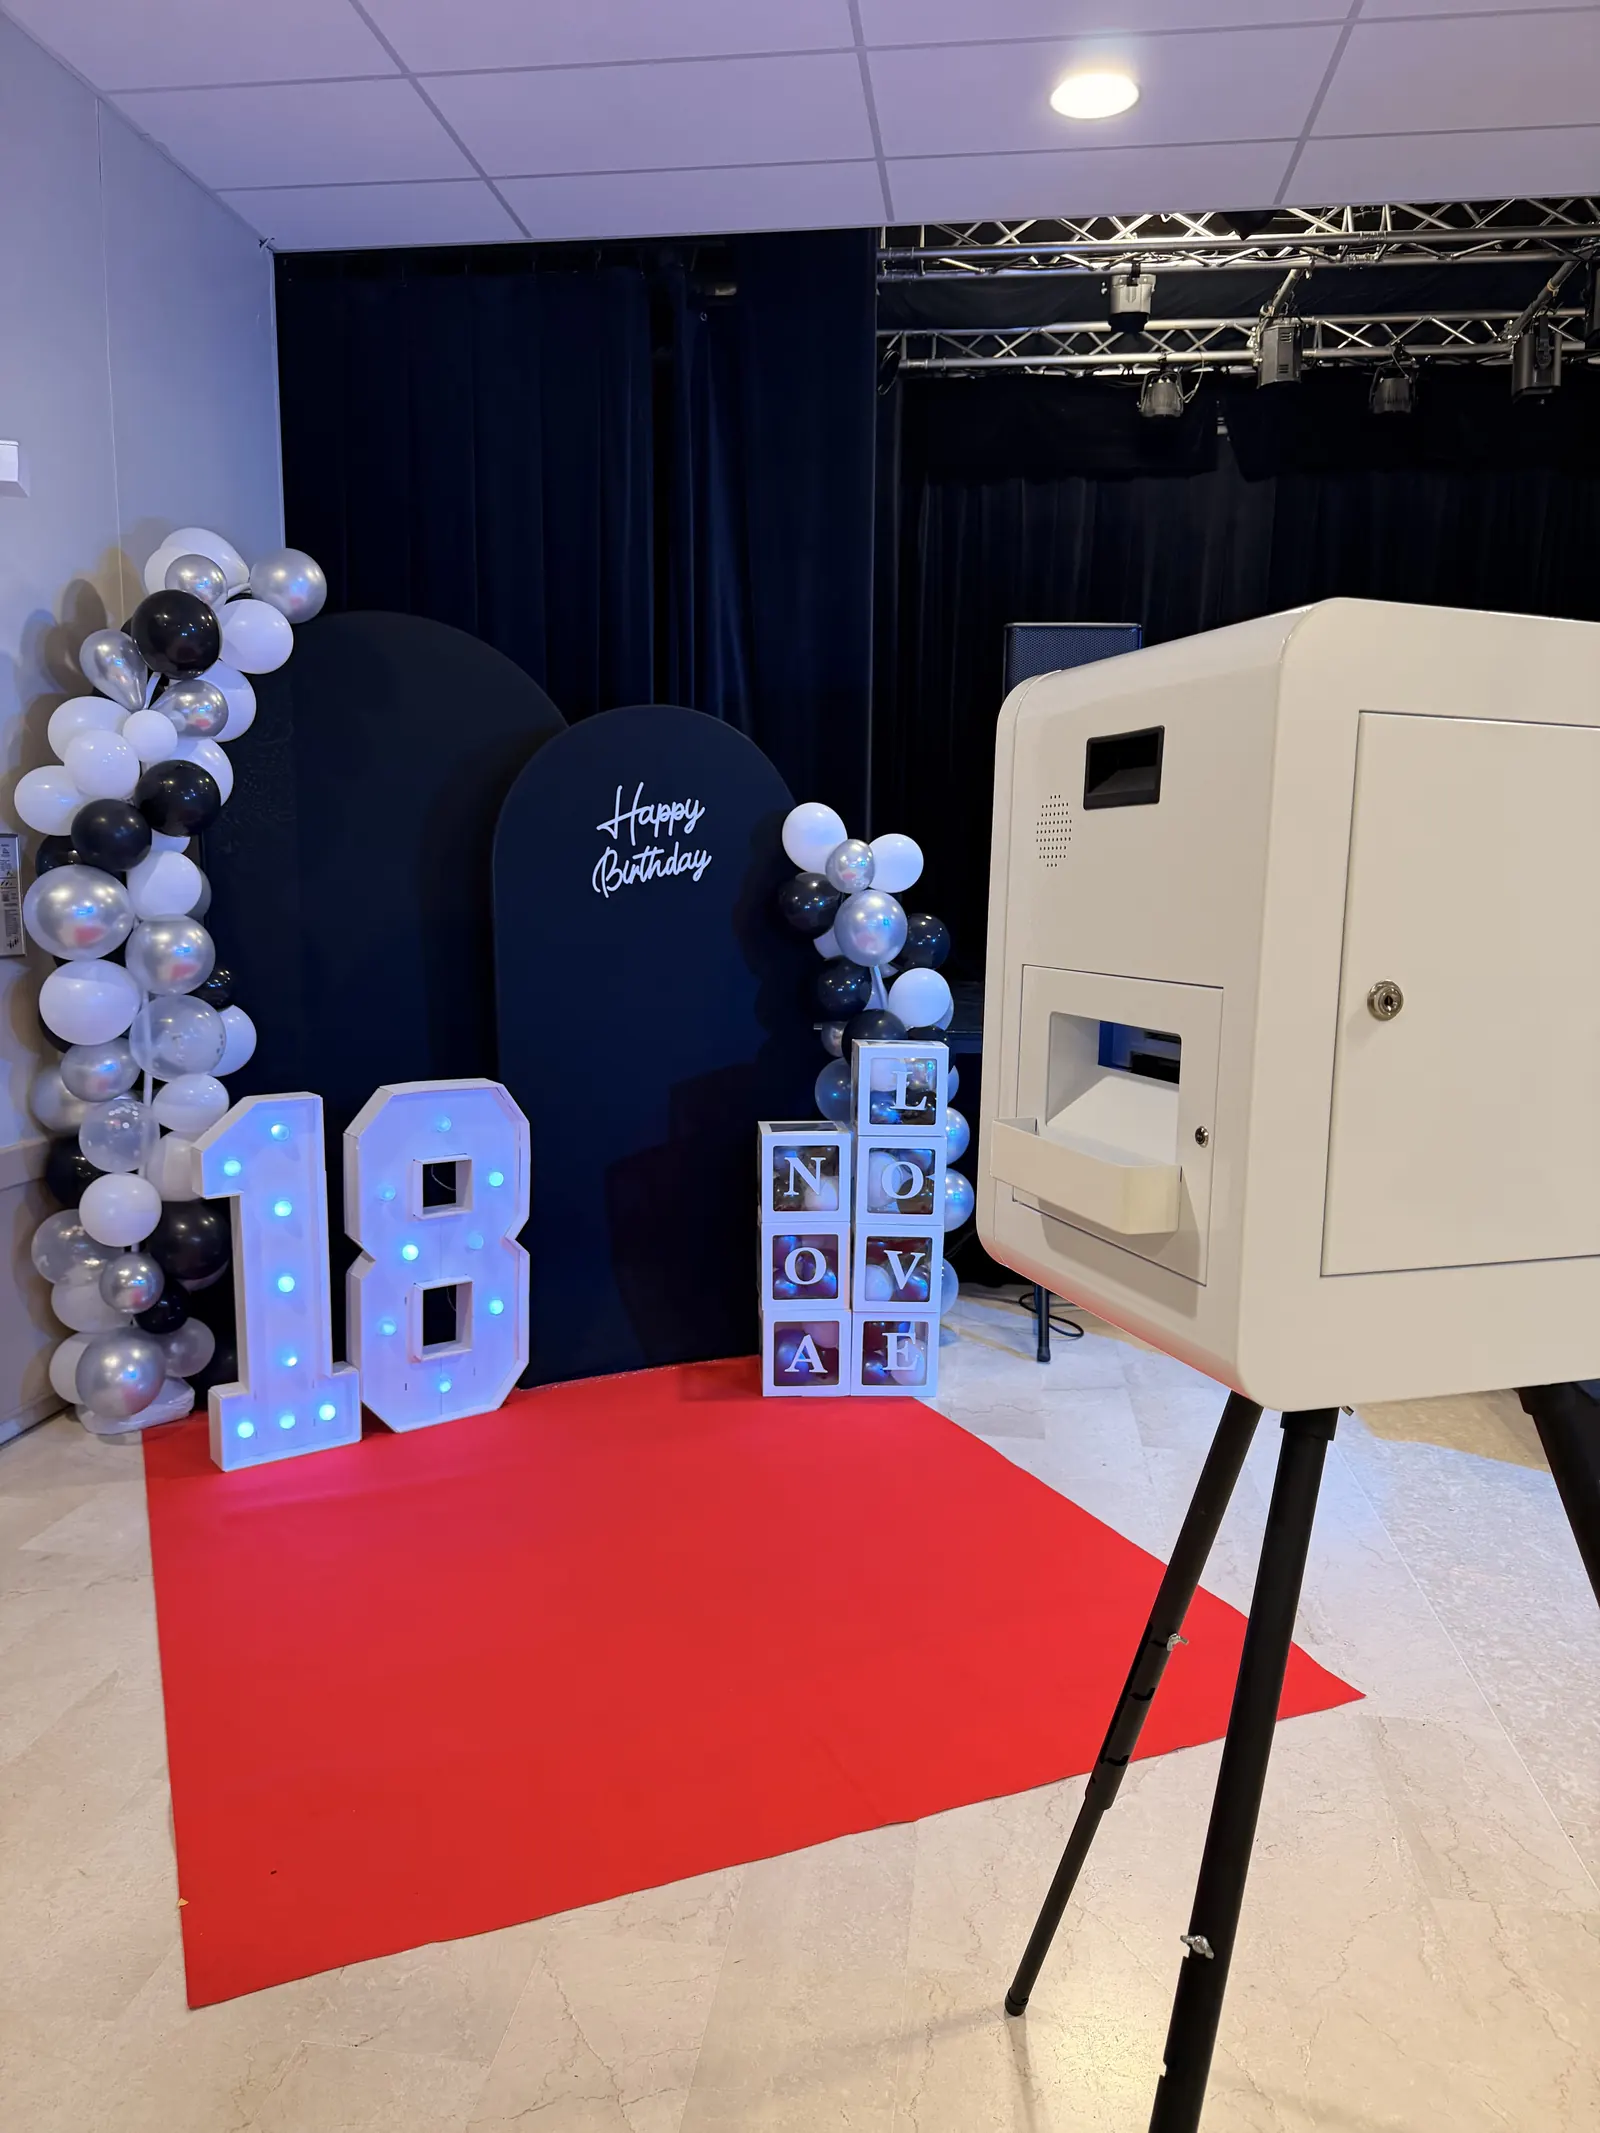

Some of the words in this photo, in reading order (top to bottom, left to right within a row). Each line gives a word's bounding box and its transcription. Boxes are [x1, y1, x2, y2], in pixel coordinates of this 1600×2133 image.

[596, 781, 705, 846] Happy
[592, 841, 712, 898] Birthday
[191, 1077, 532, 1473] 18
